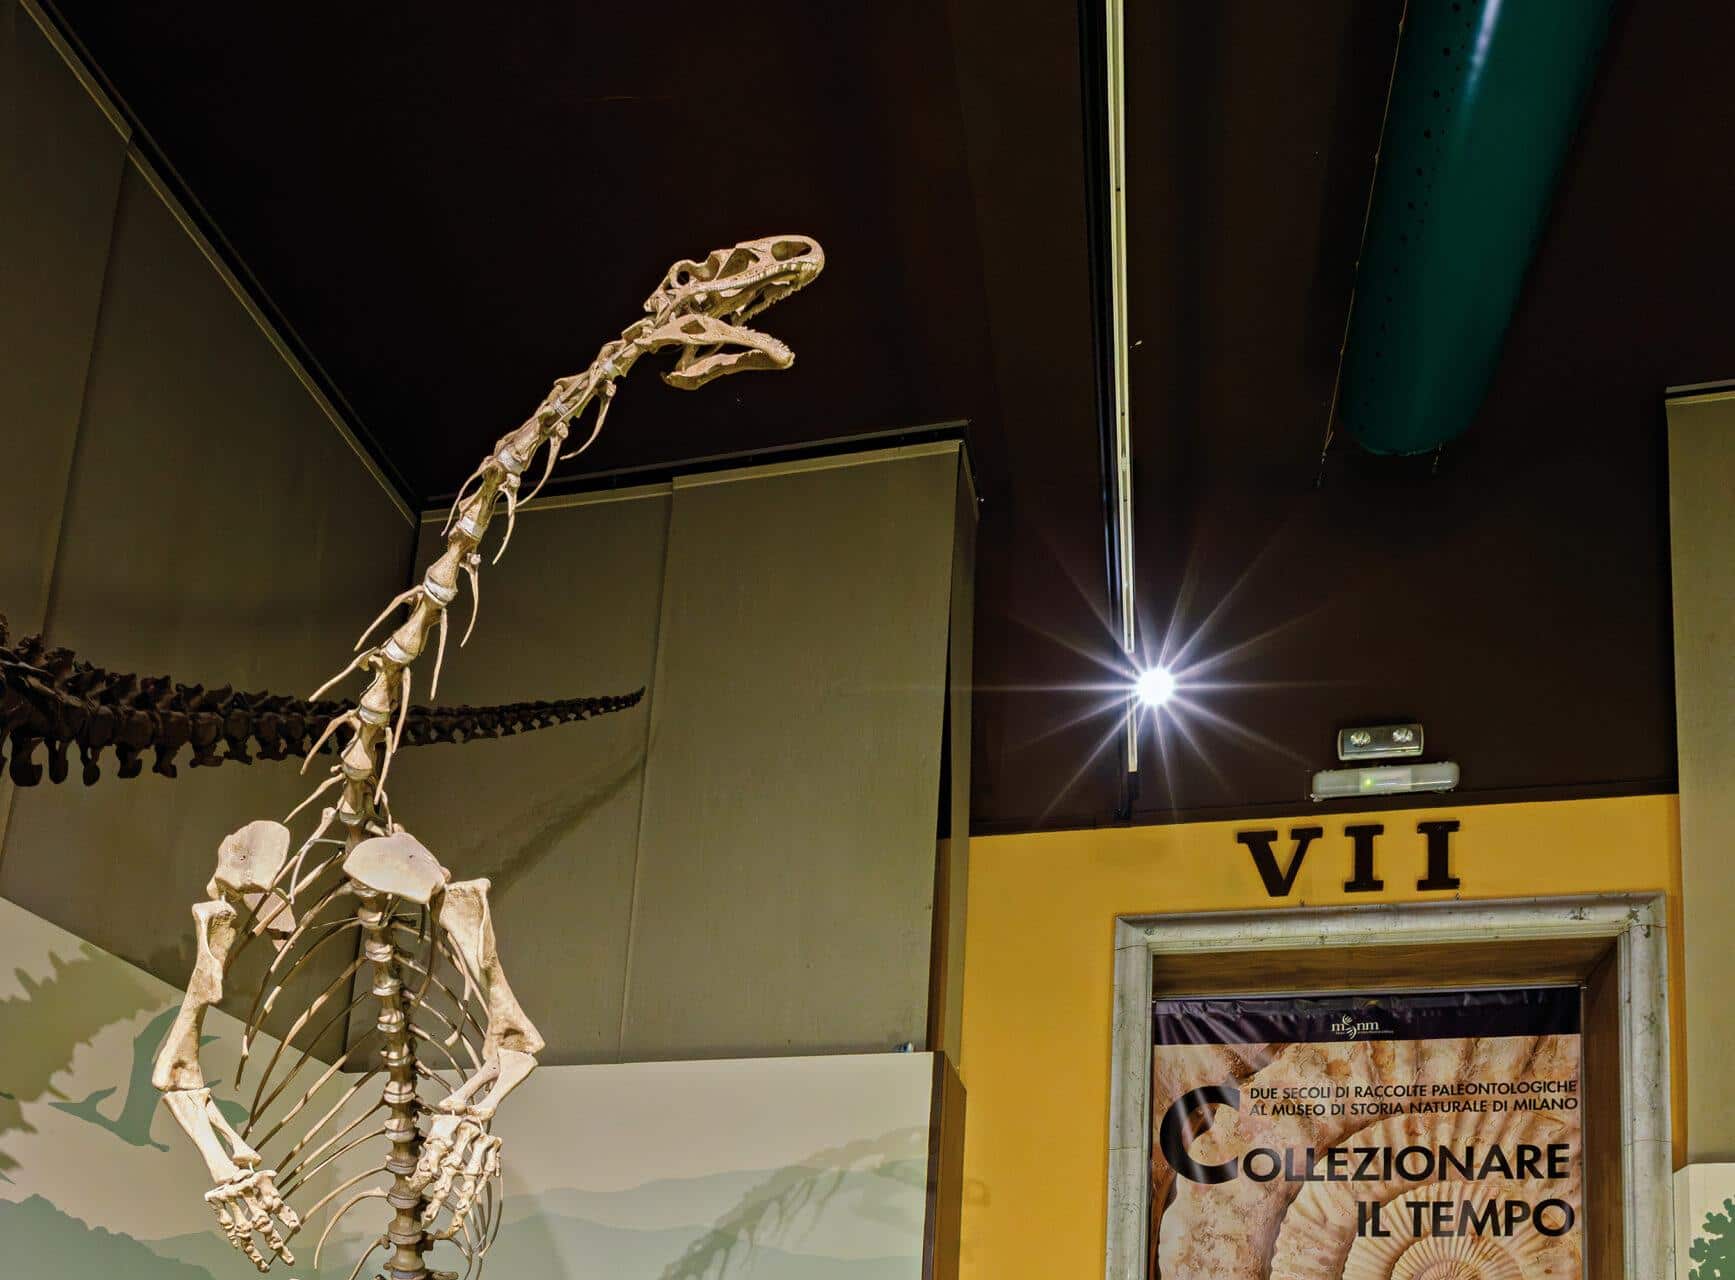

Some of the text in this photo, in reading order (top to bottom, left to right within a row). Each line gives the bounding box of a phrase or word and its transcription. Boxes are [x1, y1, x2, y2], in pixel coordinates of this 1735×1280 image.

[1237, 820, 1460, 898] VII
[1249, 1096, 1579, 1117] AL MUSEO DI STORIA NATURALE DI MILANO
[1250, 1079, 1578, 1100] DUE SECOLI DI RACCOLTE PALEONTOLOGICHE
[1159, 1085, 1571, 1185] COLLEZIONARE
[1356, 1197, 1575, 1239] IL TEMPO
